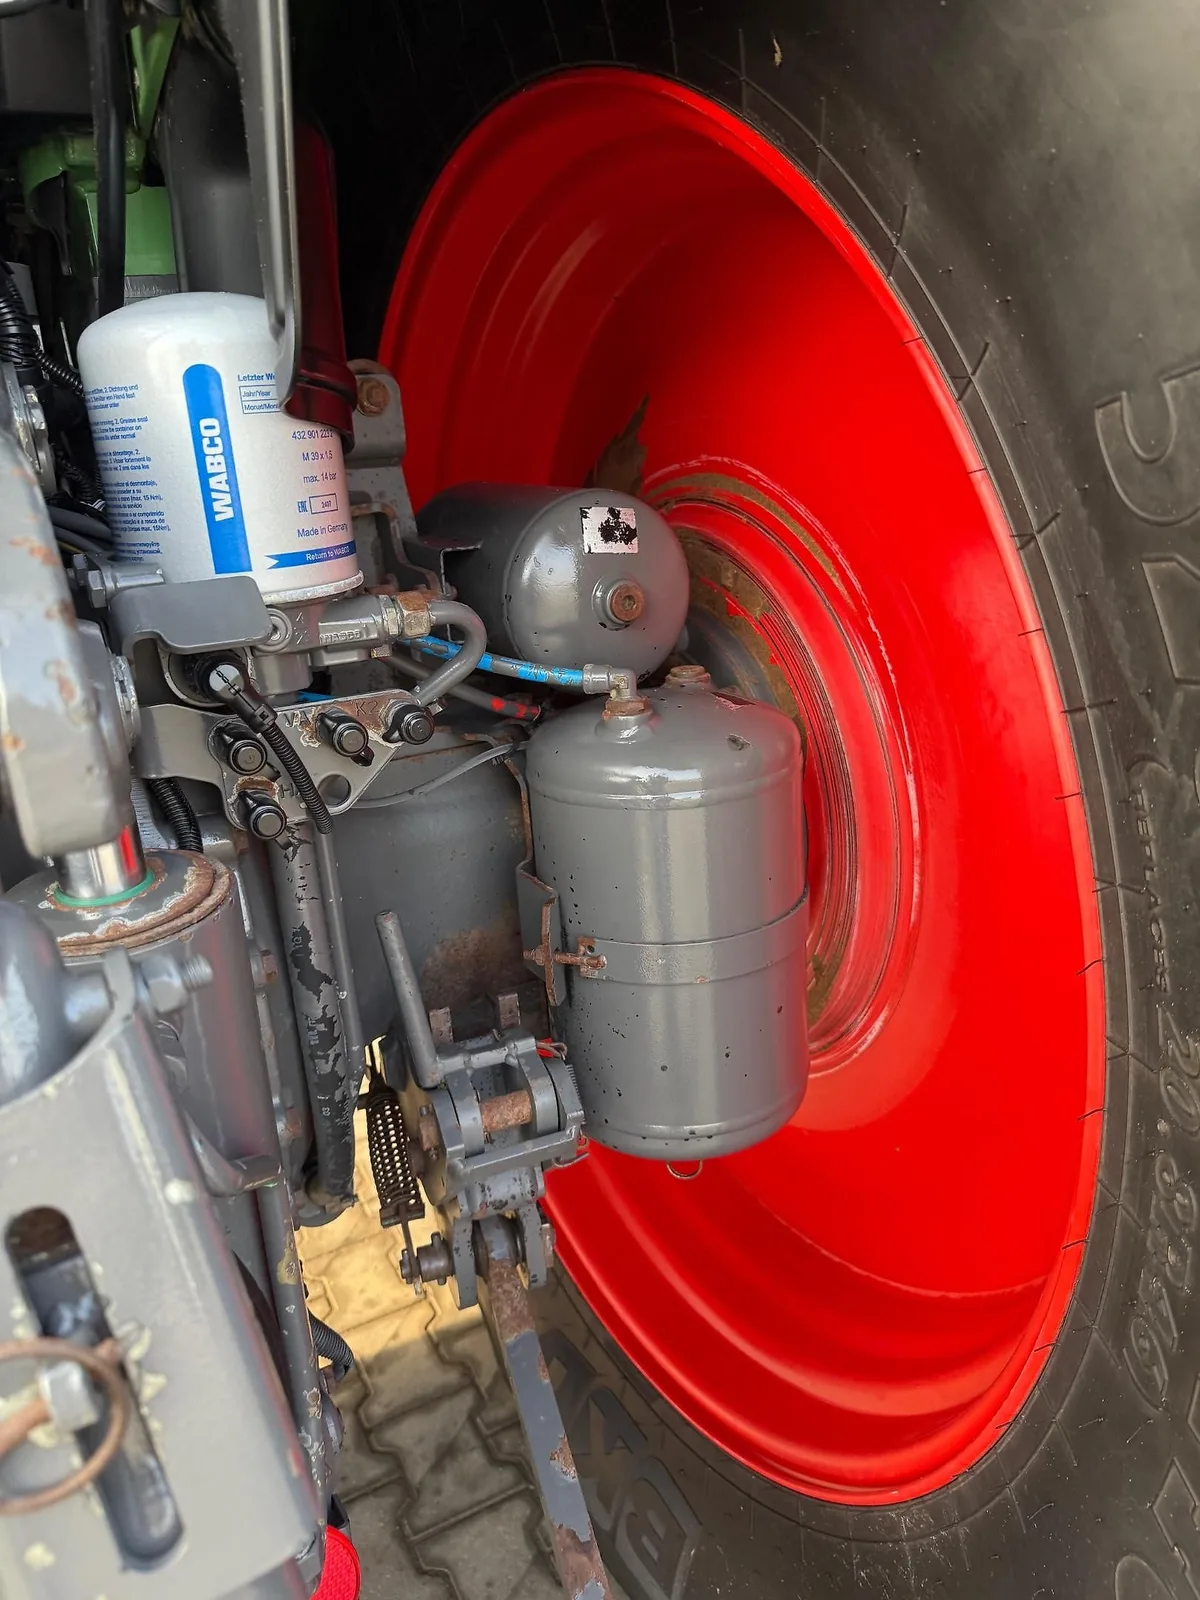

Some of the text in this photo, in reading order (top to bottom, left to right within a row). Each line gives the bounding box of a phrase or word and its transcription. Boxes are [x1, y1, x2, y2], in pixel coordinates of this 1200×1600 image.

[238, 373, 264, 381] Letzter
[291, 430, 306, 440] 432
[307, 429, 319, 439] 901
[302, 452, 310, 461] M
[311, 451, 319, 461] 39
[199, 418, 234, 522] WABCO
[303, 472, 337, 483] max. 14 bar
[297, 527, 319, 538] Made
[320, 525, 327, 534] in
[306, 552, 327, 561] Return
[328, 550, 334, 558] to
[355, 700, 378, 717] K2
